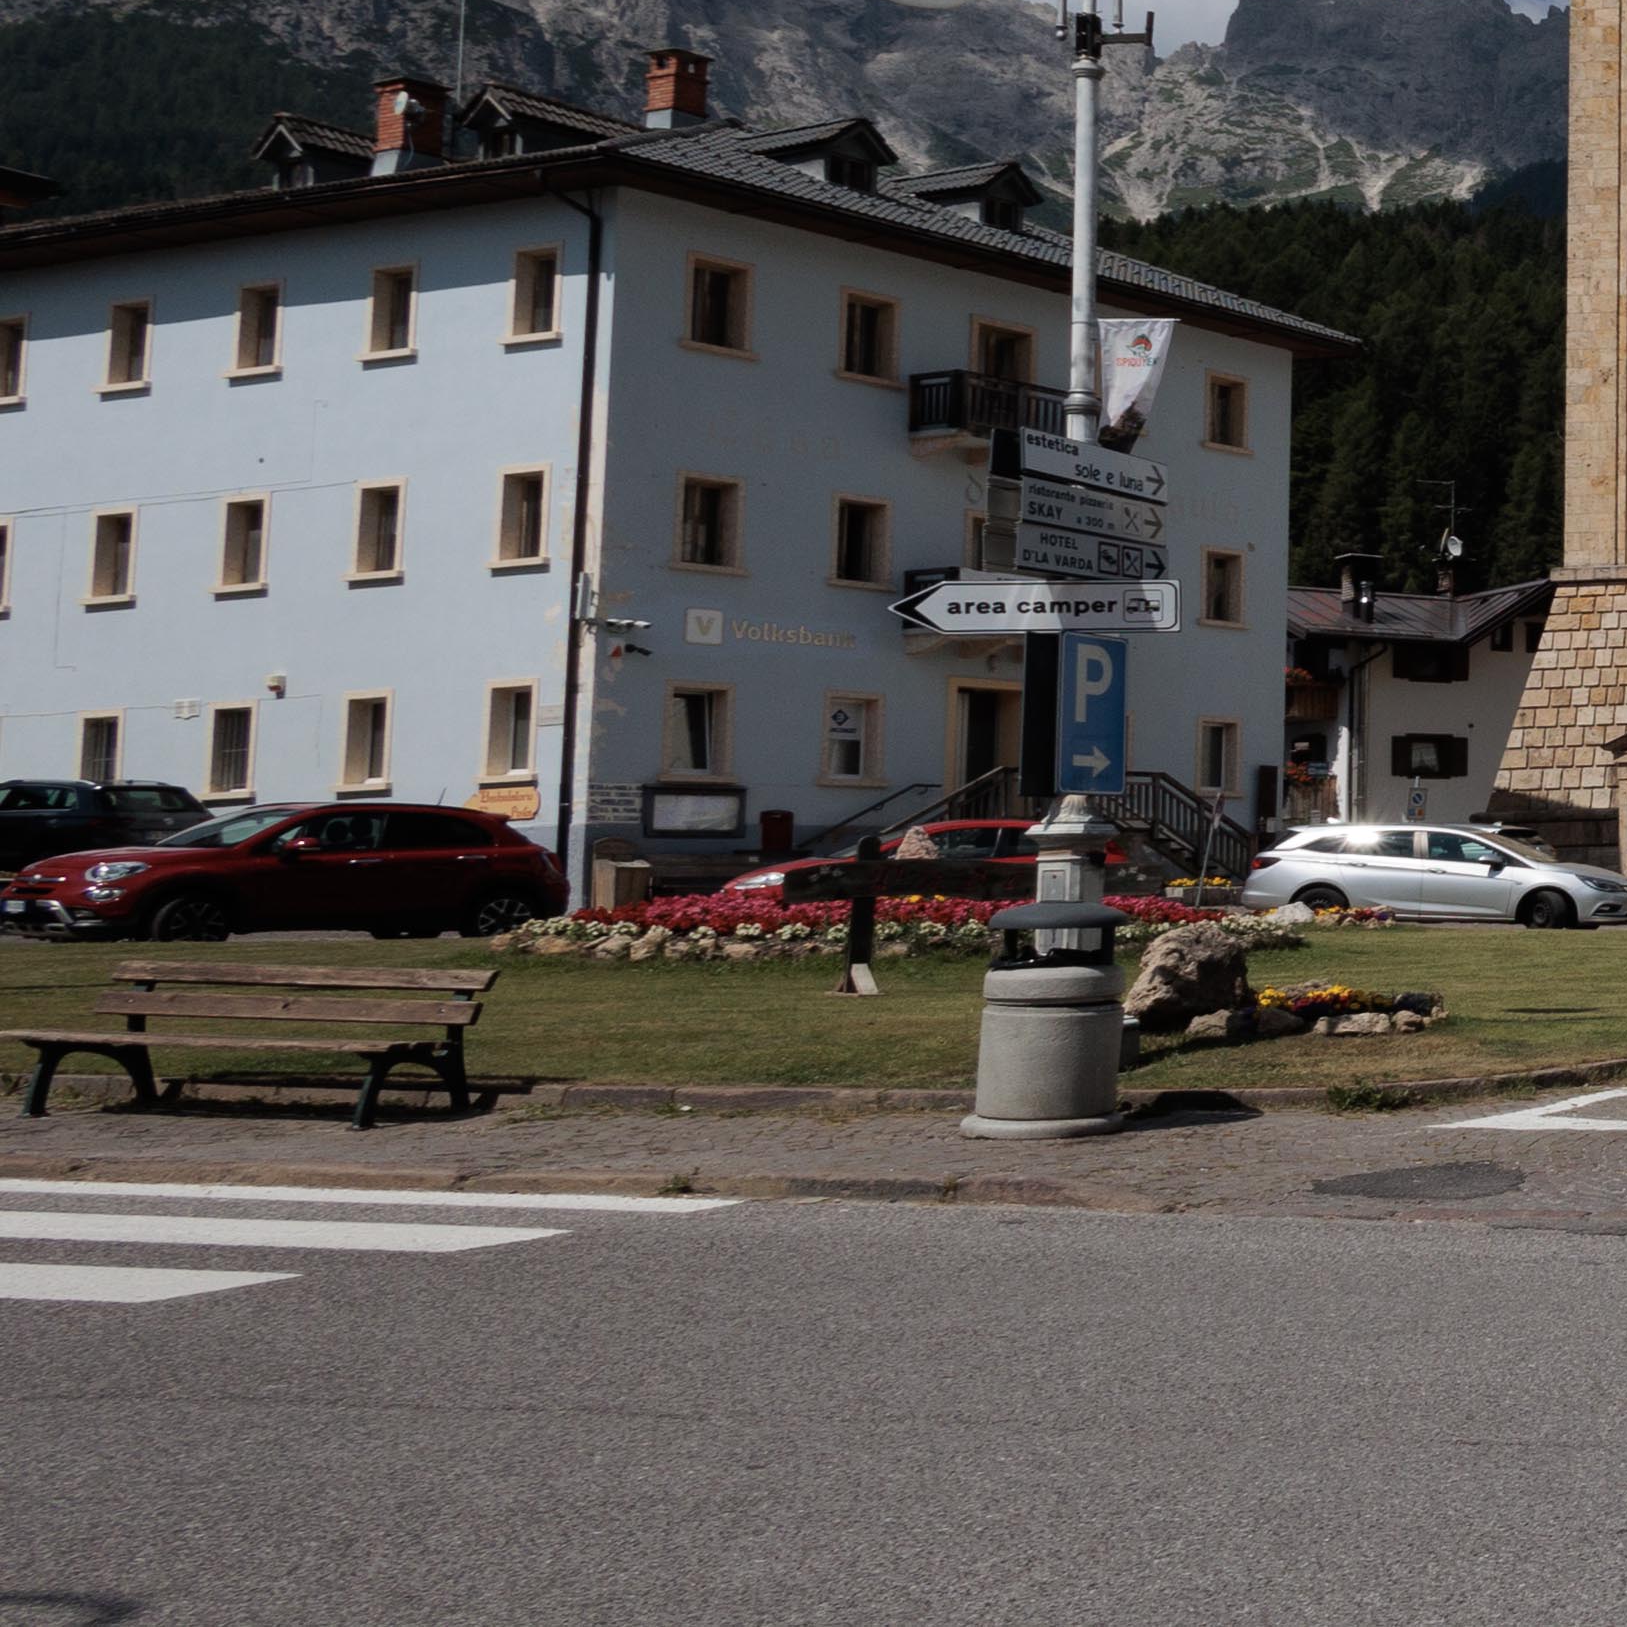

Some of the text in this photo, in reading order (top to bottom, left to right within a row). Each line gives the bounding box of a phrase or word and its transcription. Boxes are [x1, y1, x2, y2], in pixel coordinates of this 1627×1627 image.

[1026, 432, 1079, 456] estetica
[1074, 463, 1145, 493] sole e luna
[1028, 484, 1076, 503] ristorante
[1027, 501, 1063, 521] SKAY
[1040, 533, 1079, 550] HOTEL
[1022, 548, 1094, 571] D'LA VARDA
[947, 599, 1117, 617] area camper
[731, 619, 857, 648] Volksbank
[1074, 642, 1113, 723] P
